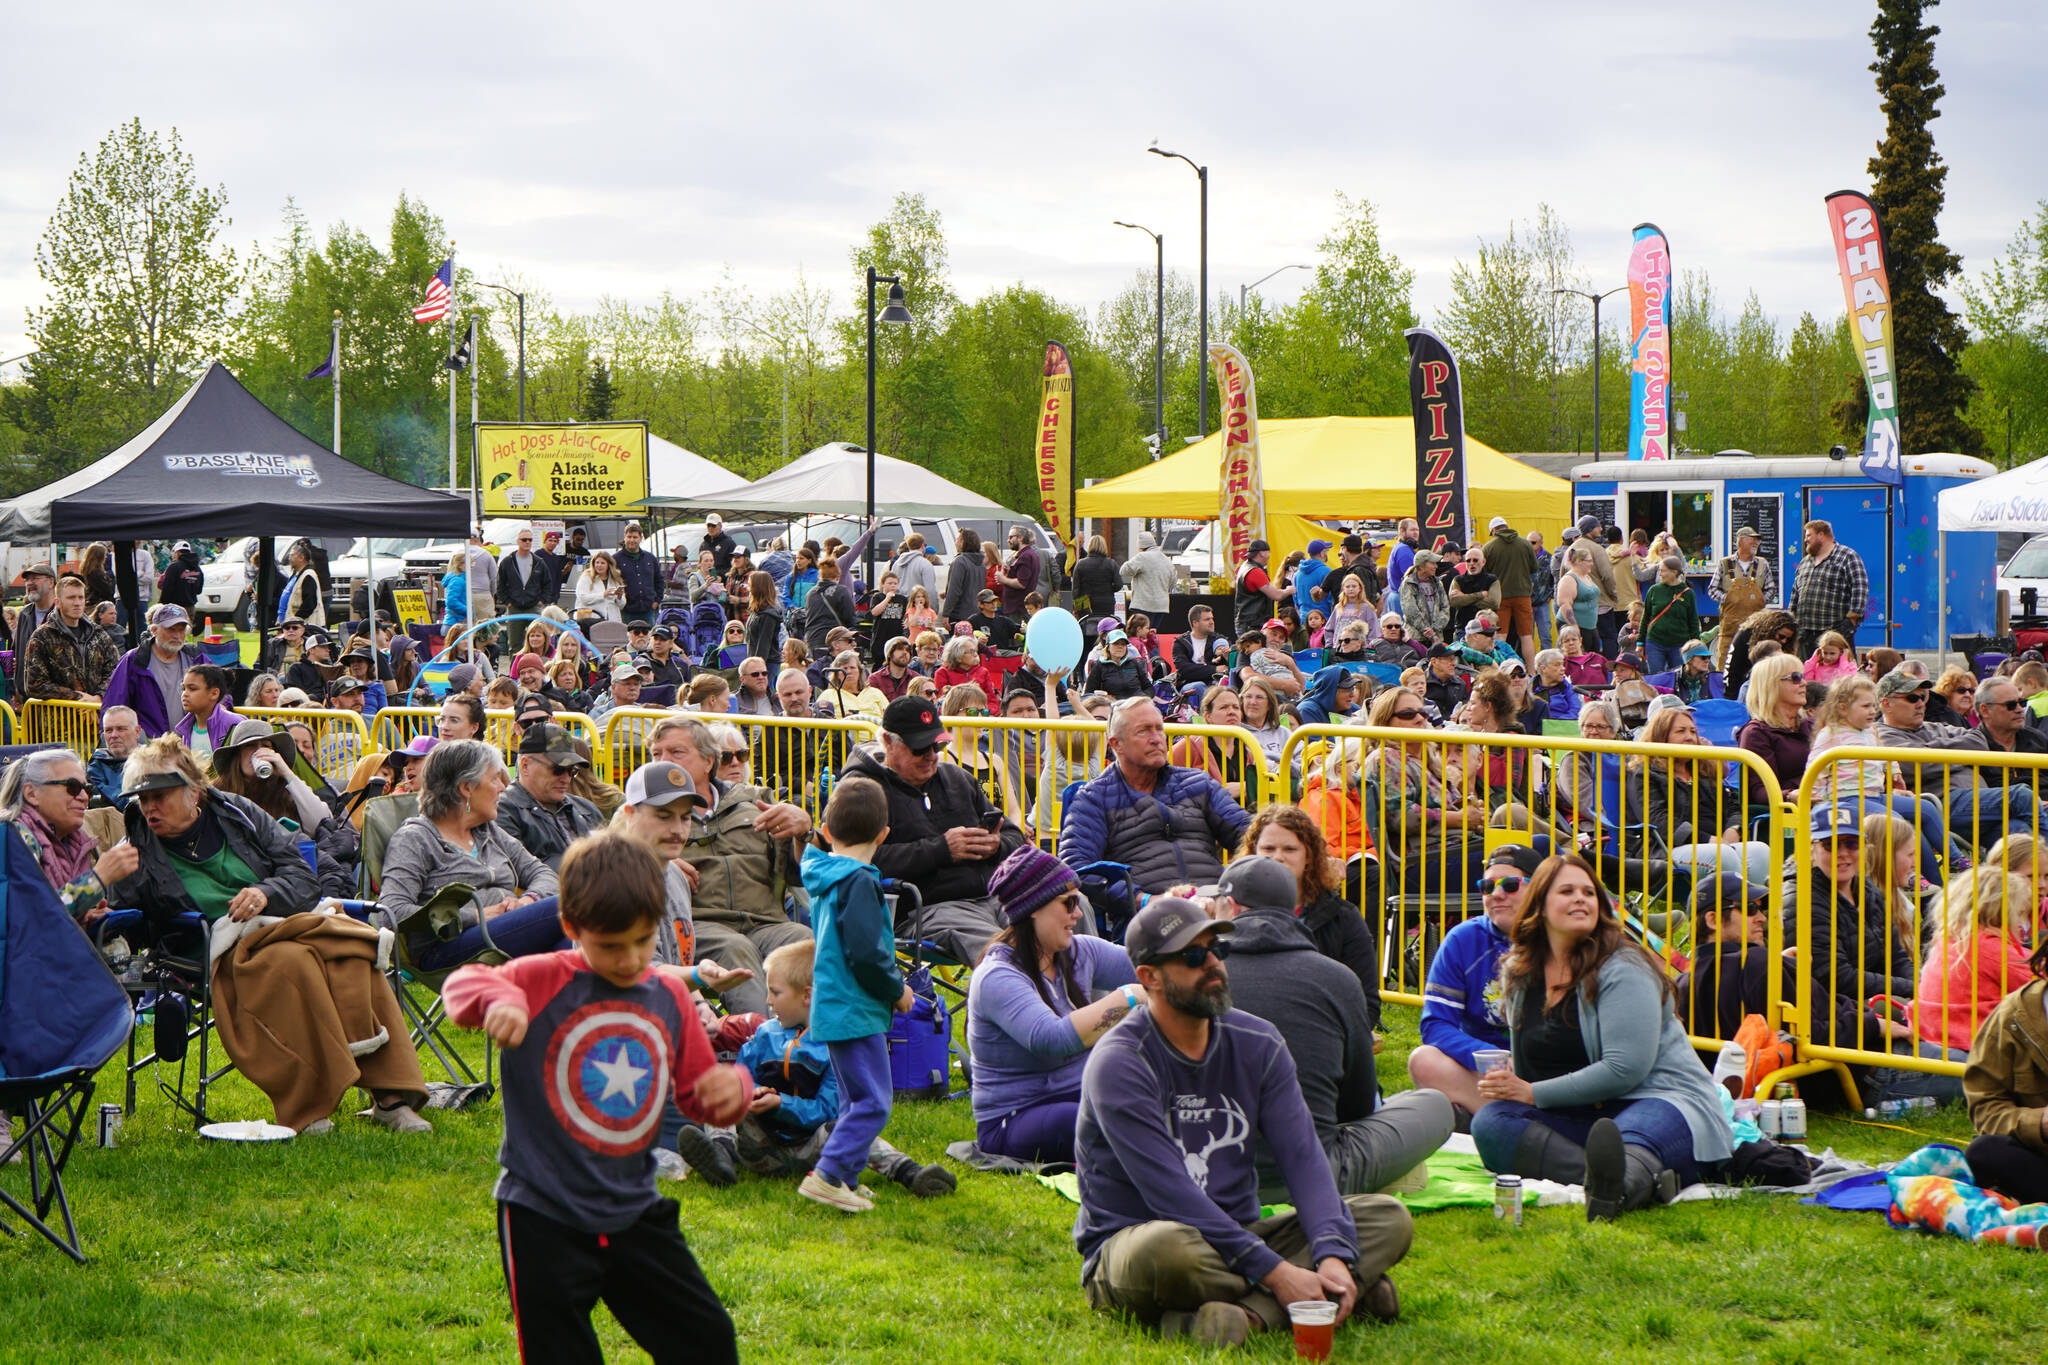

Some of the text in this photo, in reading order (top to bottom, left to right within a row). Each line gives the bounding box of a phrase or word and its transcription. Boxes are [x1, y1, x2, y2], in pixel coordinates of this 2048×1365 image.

[1225, 361, 1249, 447] LEMON
[492, 431, 632, 462] Hot Dogs A-la-Carte
[1040, 397, 1060, 492] CHEESE
[527, 448, 560, 460] Gourmet
[240, 467, 316, 476] SOUND
[551, 462, 608, 475] Alaska
[551, 477, 624, 491] Reindeer
[551, 492, 617, 509] Sausage
